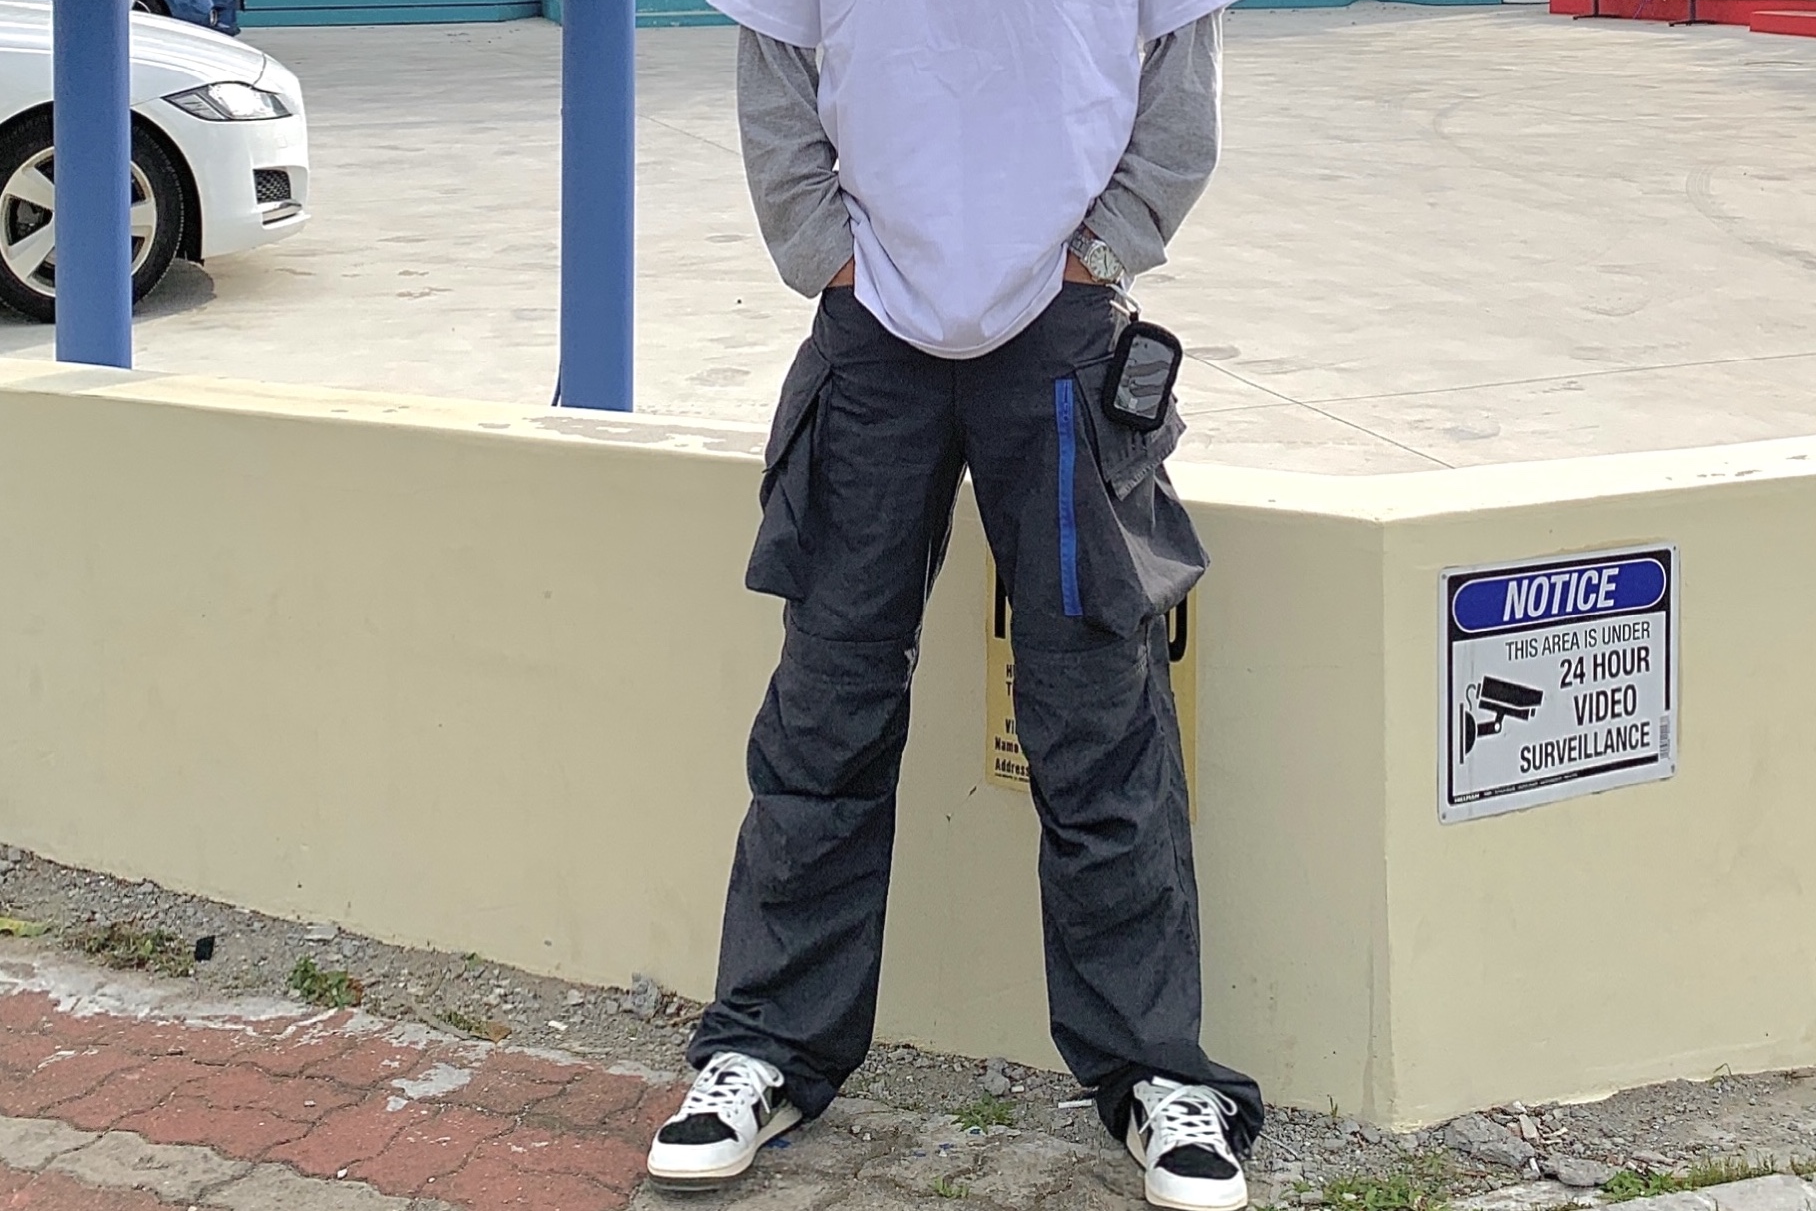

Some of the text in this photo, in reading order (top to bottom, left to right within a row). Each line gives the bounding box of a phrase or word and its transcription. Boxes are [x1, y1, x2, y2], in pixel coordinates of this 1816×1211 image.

[1502, 566, 1620, 622] NOTICE
[1505, 621, 1650, 661] THIS AREA IS UNDER
[1559, 646, 1650, 689] 24 HOUR
[1573, 684, 1637, 726] VIDEO
[994, 736, 1019, 754] Name
[1519, 721, 1650, 773] SURVEILLANCE
